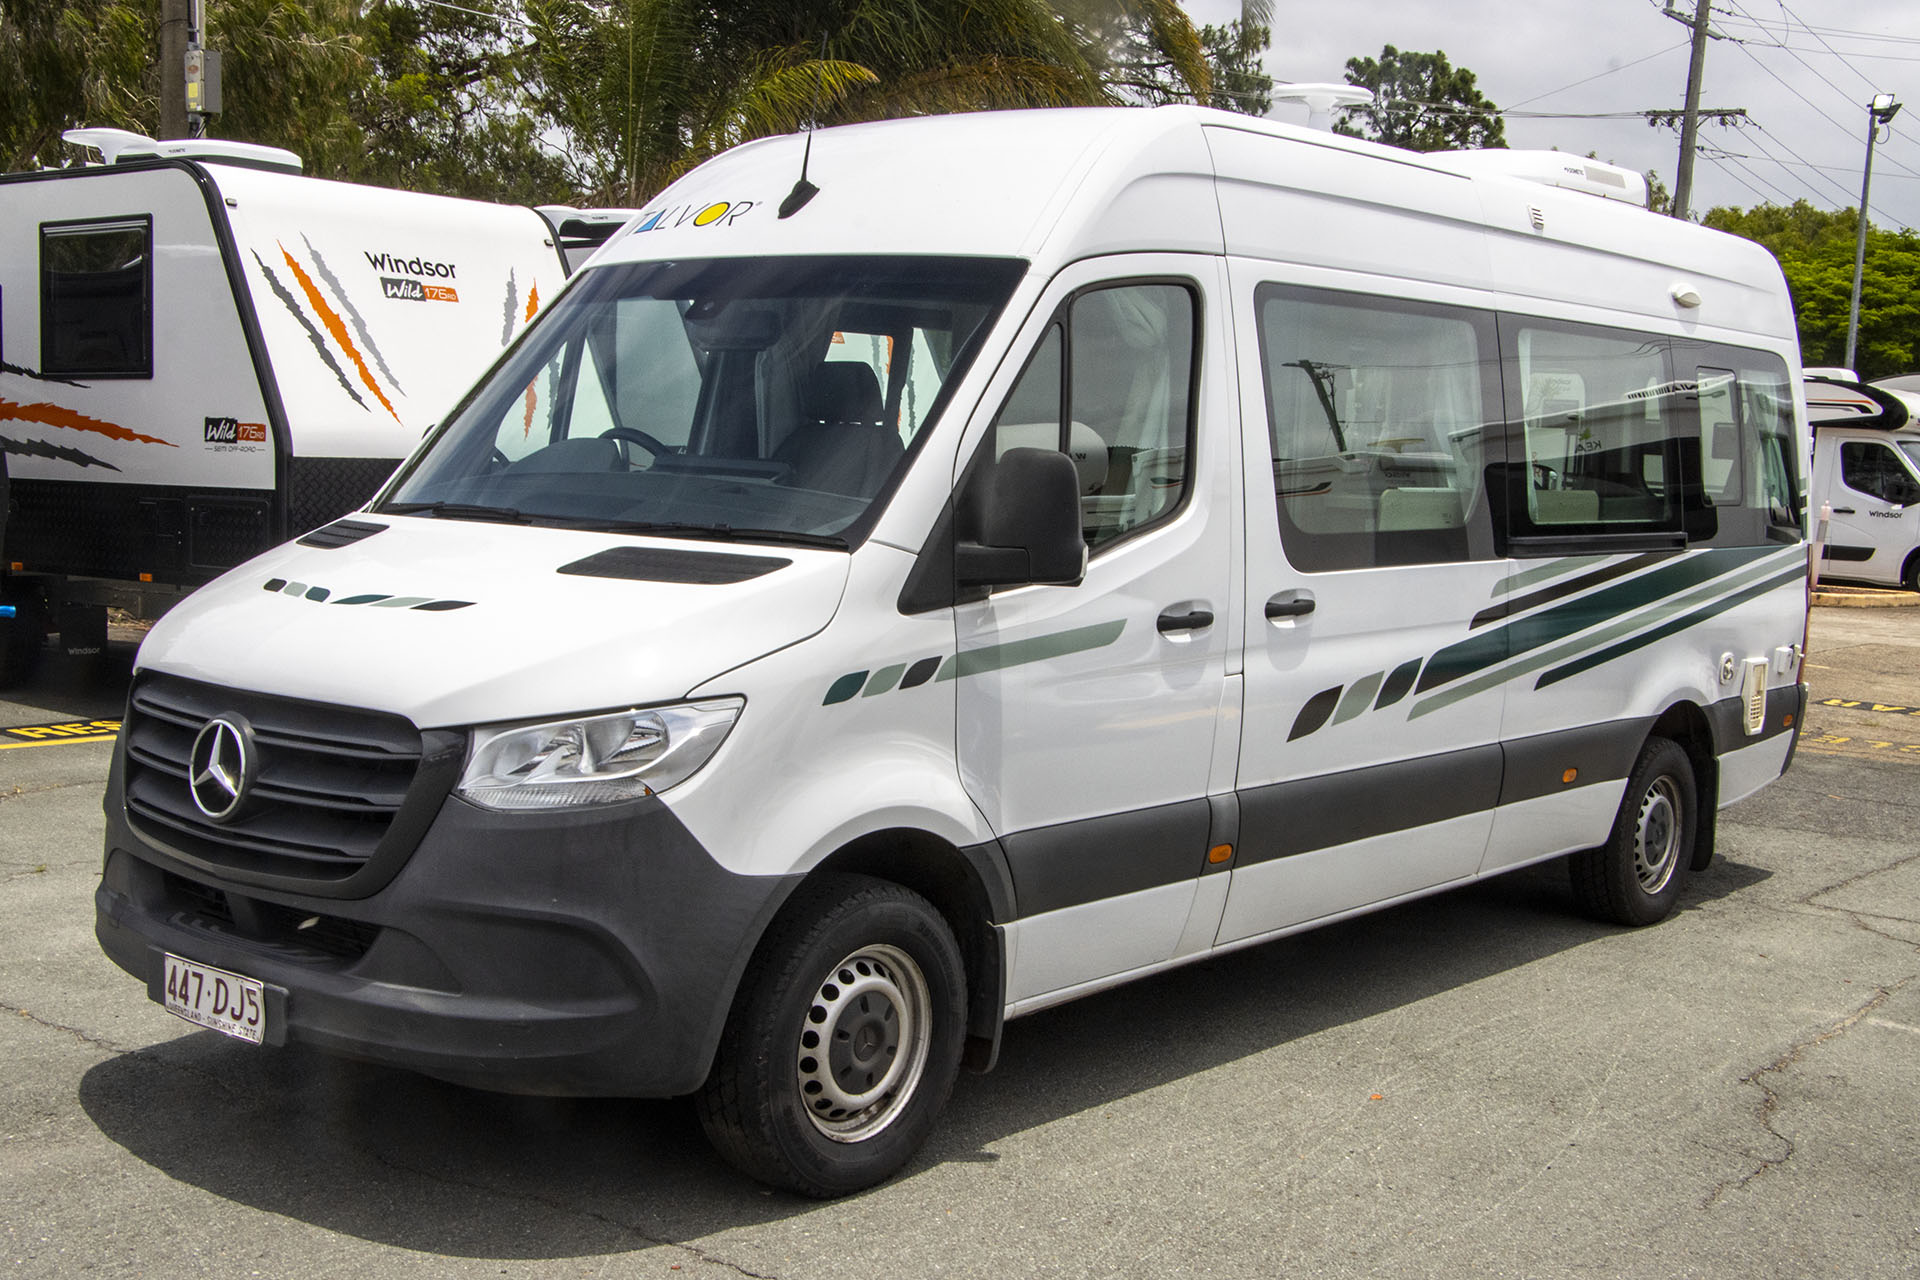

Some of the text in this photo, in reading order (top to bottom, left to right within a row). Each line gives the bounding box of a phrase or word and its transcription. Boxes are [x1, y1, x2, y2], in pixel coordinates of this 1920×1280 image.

[363, 250, 456, 279] Windsor
[386, 280, 423, 299] Wild
[206, 419, 236, 440] Wild
